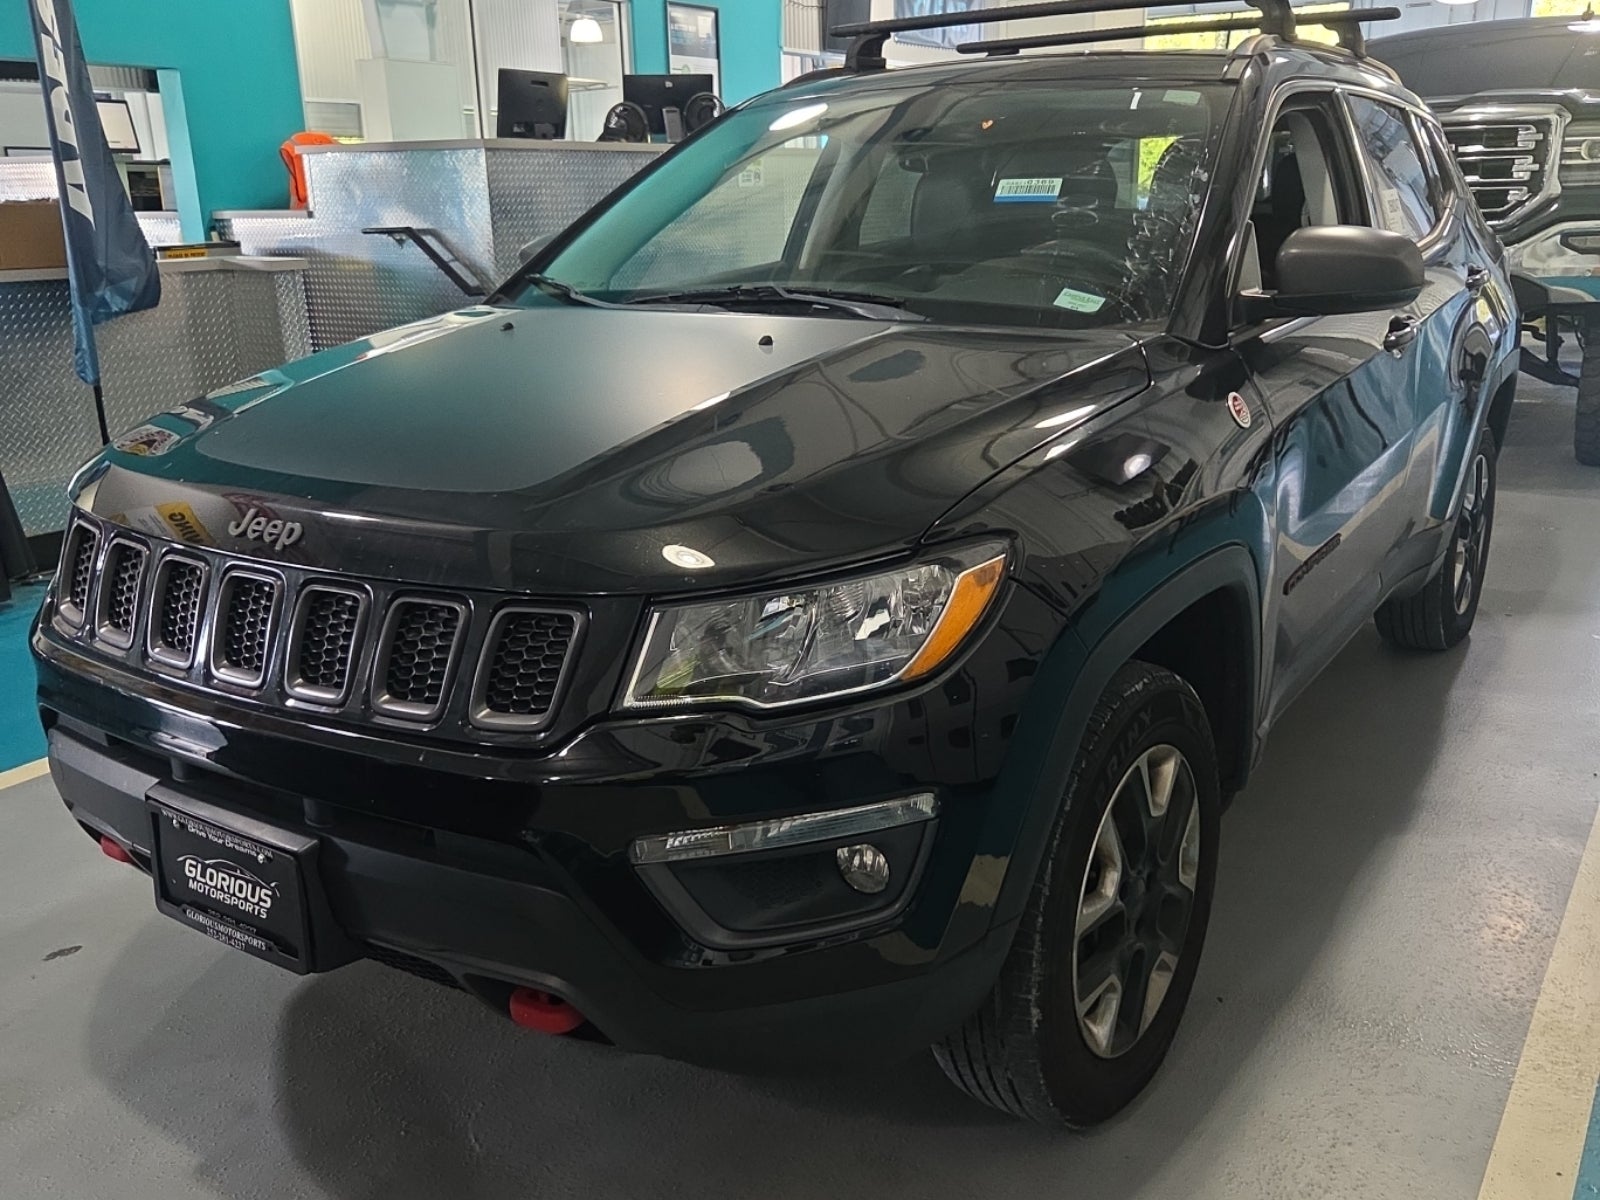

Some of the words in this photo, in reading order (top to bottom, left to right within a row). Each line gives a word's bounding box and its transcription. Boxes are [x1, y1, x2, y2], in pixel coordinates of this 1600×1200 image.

[228, 508, 303, 551] Jeep
[187, 824, 207, 838] Drive
[206, 828, 223, 844] Your
[225, 837, 257, 857] Dreams
[184, 858, 272, 909] GLORIOUS
[188, 878, 268, 919] MOTORSPORTS
[186, 908, 266, 951] GLORIOUSMOTORSPORTS
